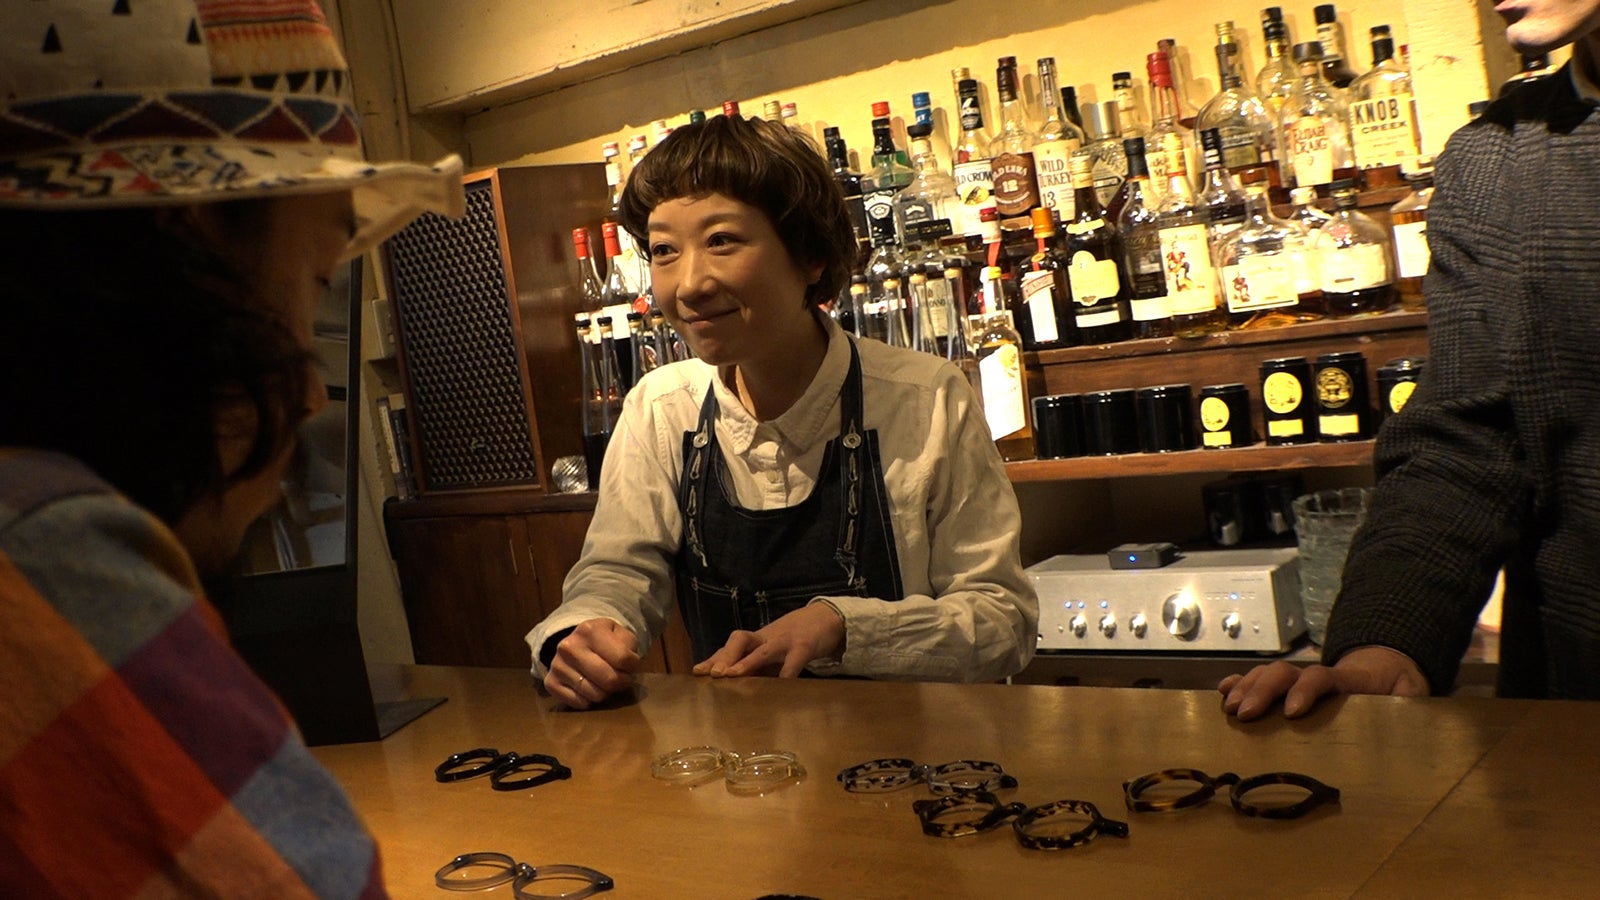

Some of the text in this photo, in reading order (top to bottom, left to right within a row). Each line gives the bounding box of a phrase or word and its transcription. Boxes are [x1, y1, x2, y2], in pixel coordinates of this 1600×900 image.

[1353, 98, 1399, 124] KNOB
[1361, 120, 1407, 134] CREEK
[1039, 159, 1064, 172] WILD
[1038, 171, 1072, 189] TURKEY
[1042, 191, 1057, 208] 13
